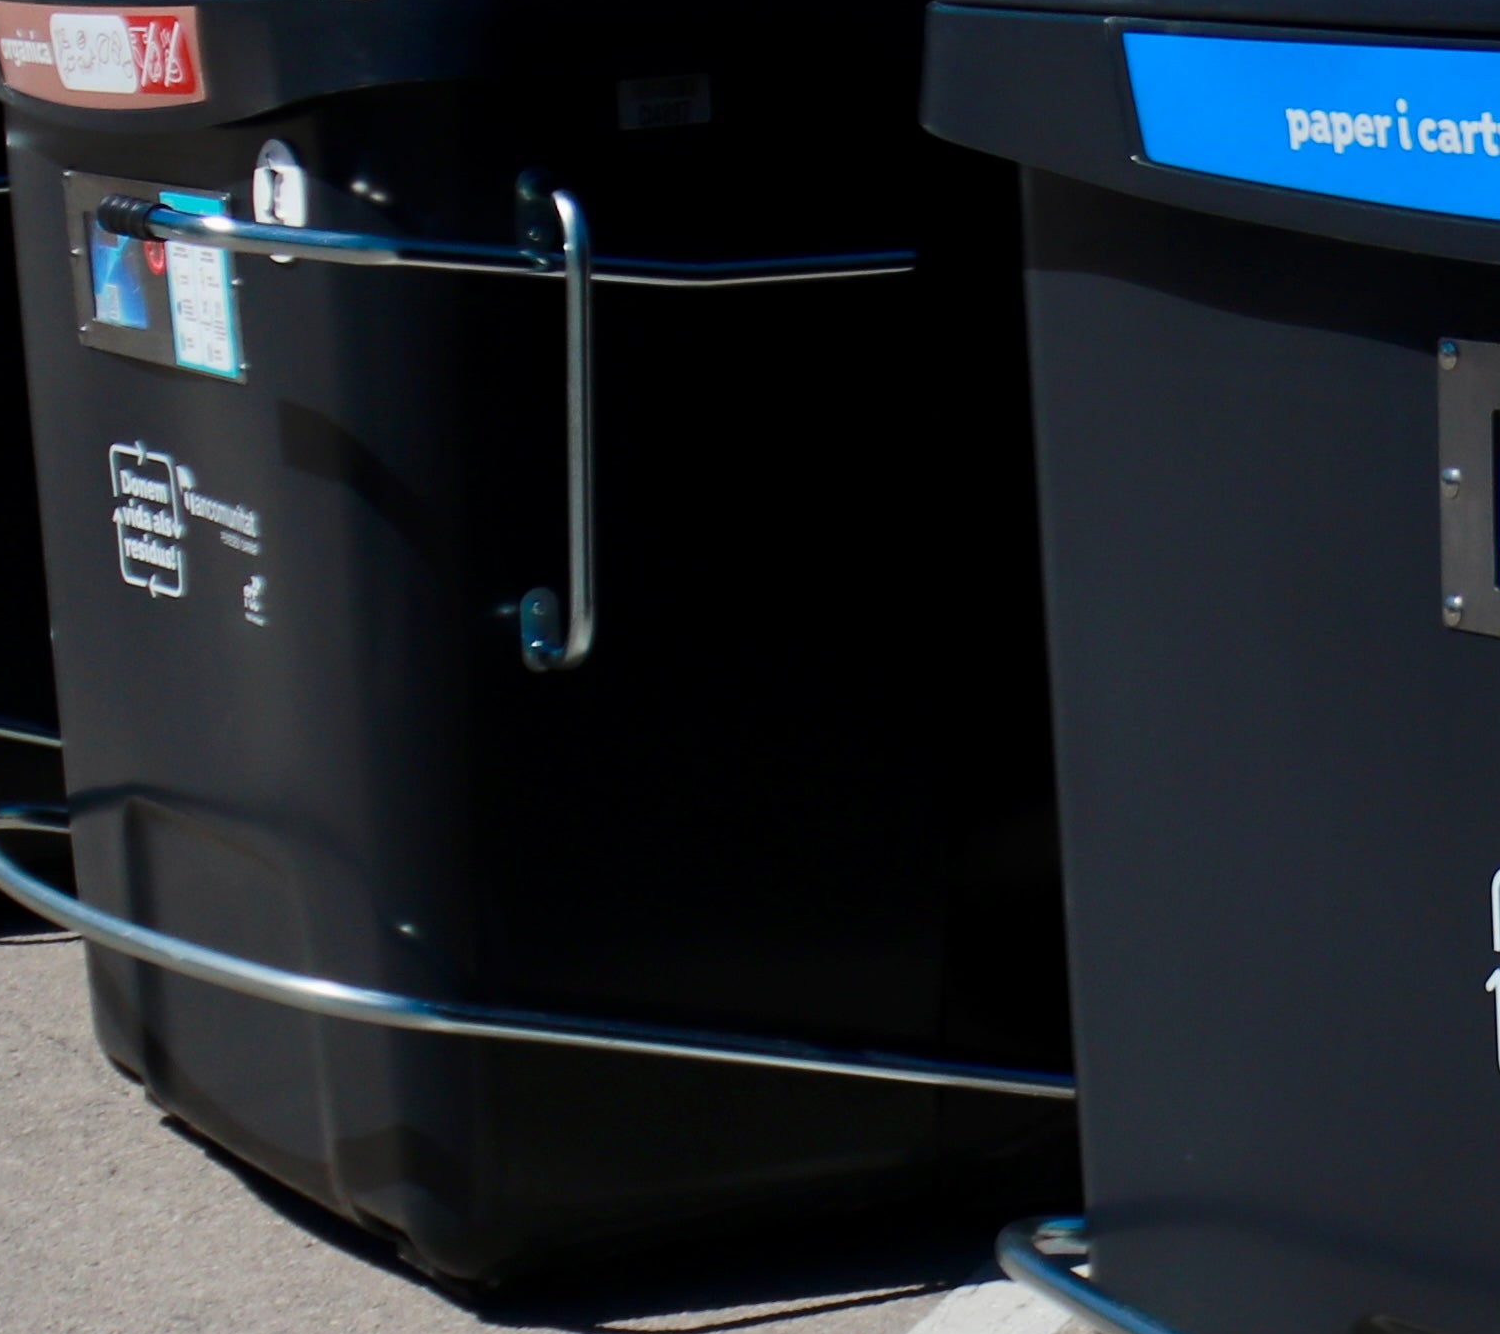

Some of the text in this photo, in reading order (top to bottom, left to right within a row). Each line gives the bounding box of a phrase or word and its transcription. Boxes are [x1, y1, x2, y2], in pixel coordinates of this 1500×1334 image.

[1285, 107, 1392, 155] paper
[1396, 98, 1412, 151] i
[120, 469, 170, 504] Donem
[122, 498, 174, 538] vida als
[124, 533, 178, 571] residus!
